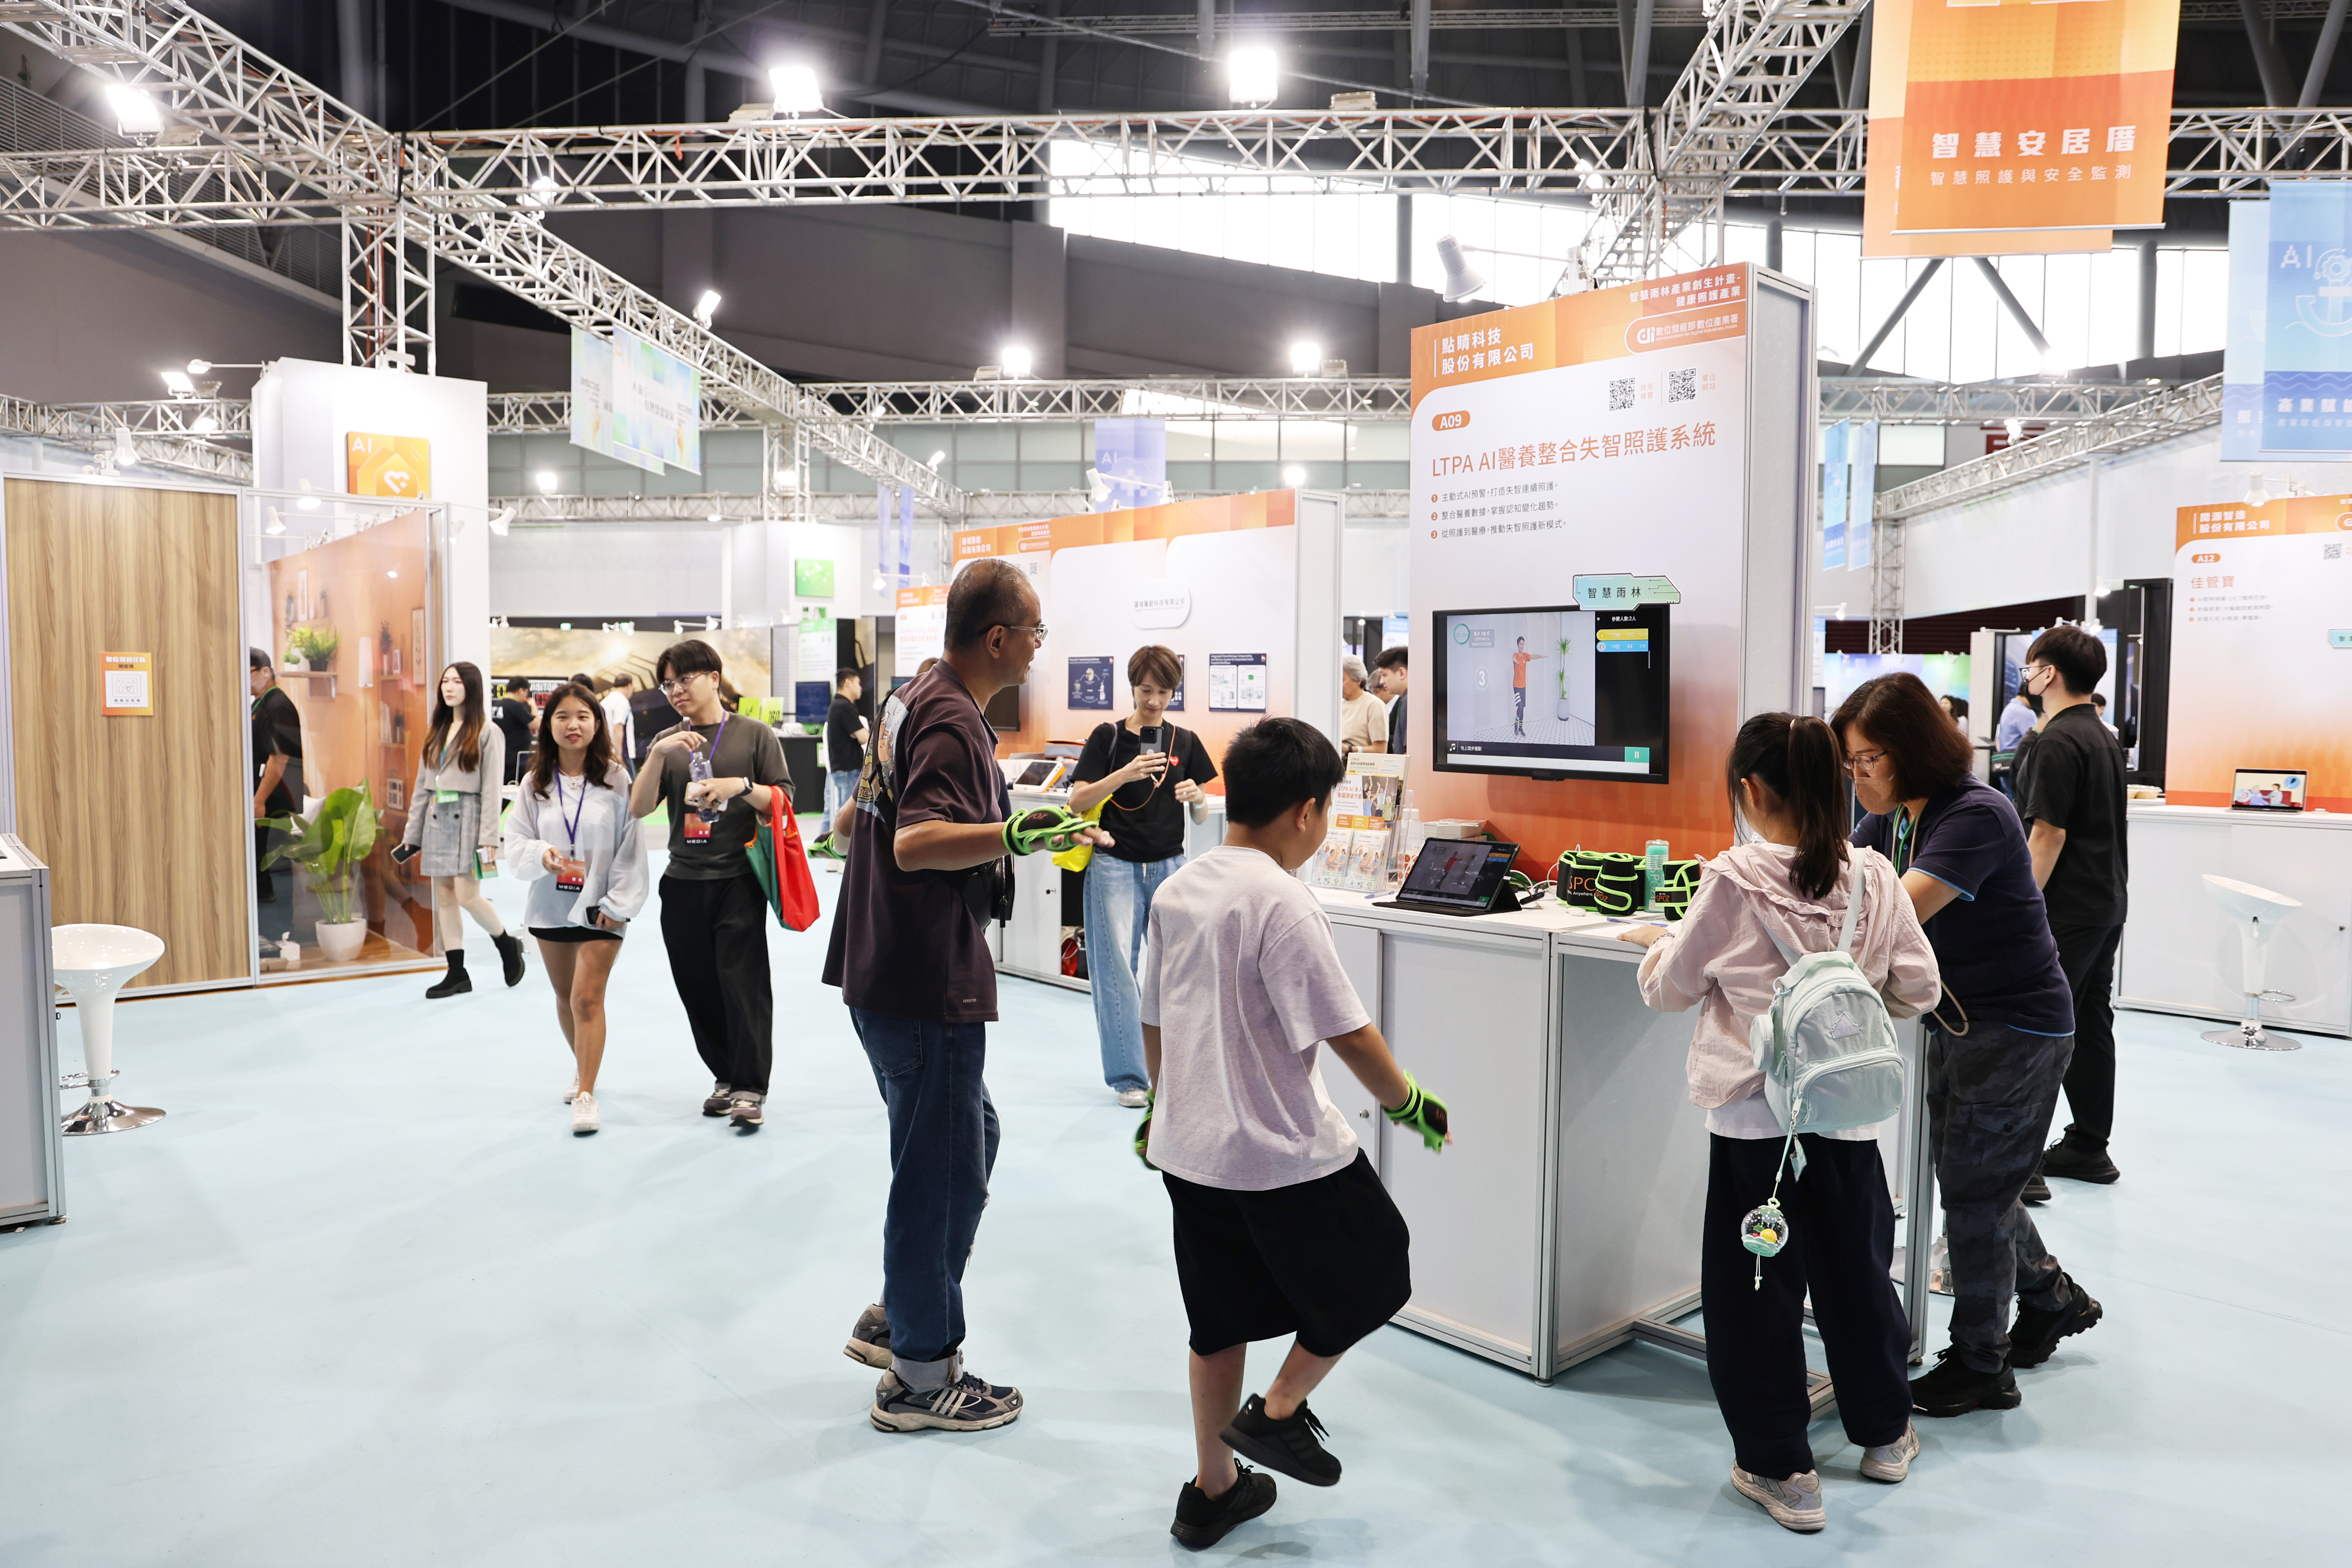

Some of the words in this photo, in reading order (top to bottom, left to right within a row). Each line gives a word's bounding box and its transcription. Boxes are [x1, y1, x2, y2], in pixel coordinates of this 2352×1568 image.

[1932, 125, 2137, 159] 智慧安居厝
[1930, 164, 2131, 186] 智慧照護與安全監測
[2280, 244, 2312, 269] AI
[1675, 286, 1740, 307] 健康照護產業
[1442, 327, 1501, 354] 點睛科技
[1656, 333, 1684, 341] Administration
[1442, 342, 1534, 375] 股份有限公司
[1702, 373, 1716, 382] 單位
[1640, 383, 1654, 391] 技術
[1701, 382, 1716, 391] 網站
[1440, 414, 1462, 429] A09
[352, 437, 372, 453] AI
[1432, 454, 1474, 476] LTPA
[1478, 421, 1716, 471] AI醫養整合失智照護系統
[2199, 520, 2271, 534] 股份有限公司
[2196, 554, 2215, 563] A12
[2191, 575, 2235, 589] 佳管寶
[1587, 586, 1641, 599] 智慧雨林
[1479, 671, 1485, 686] 3
